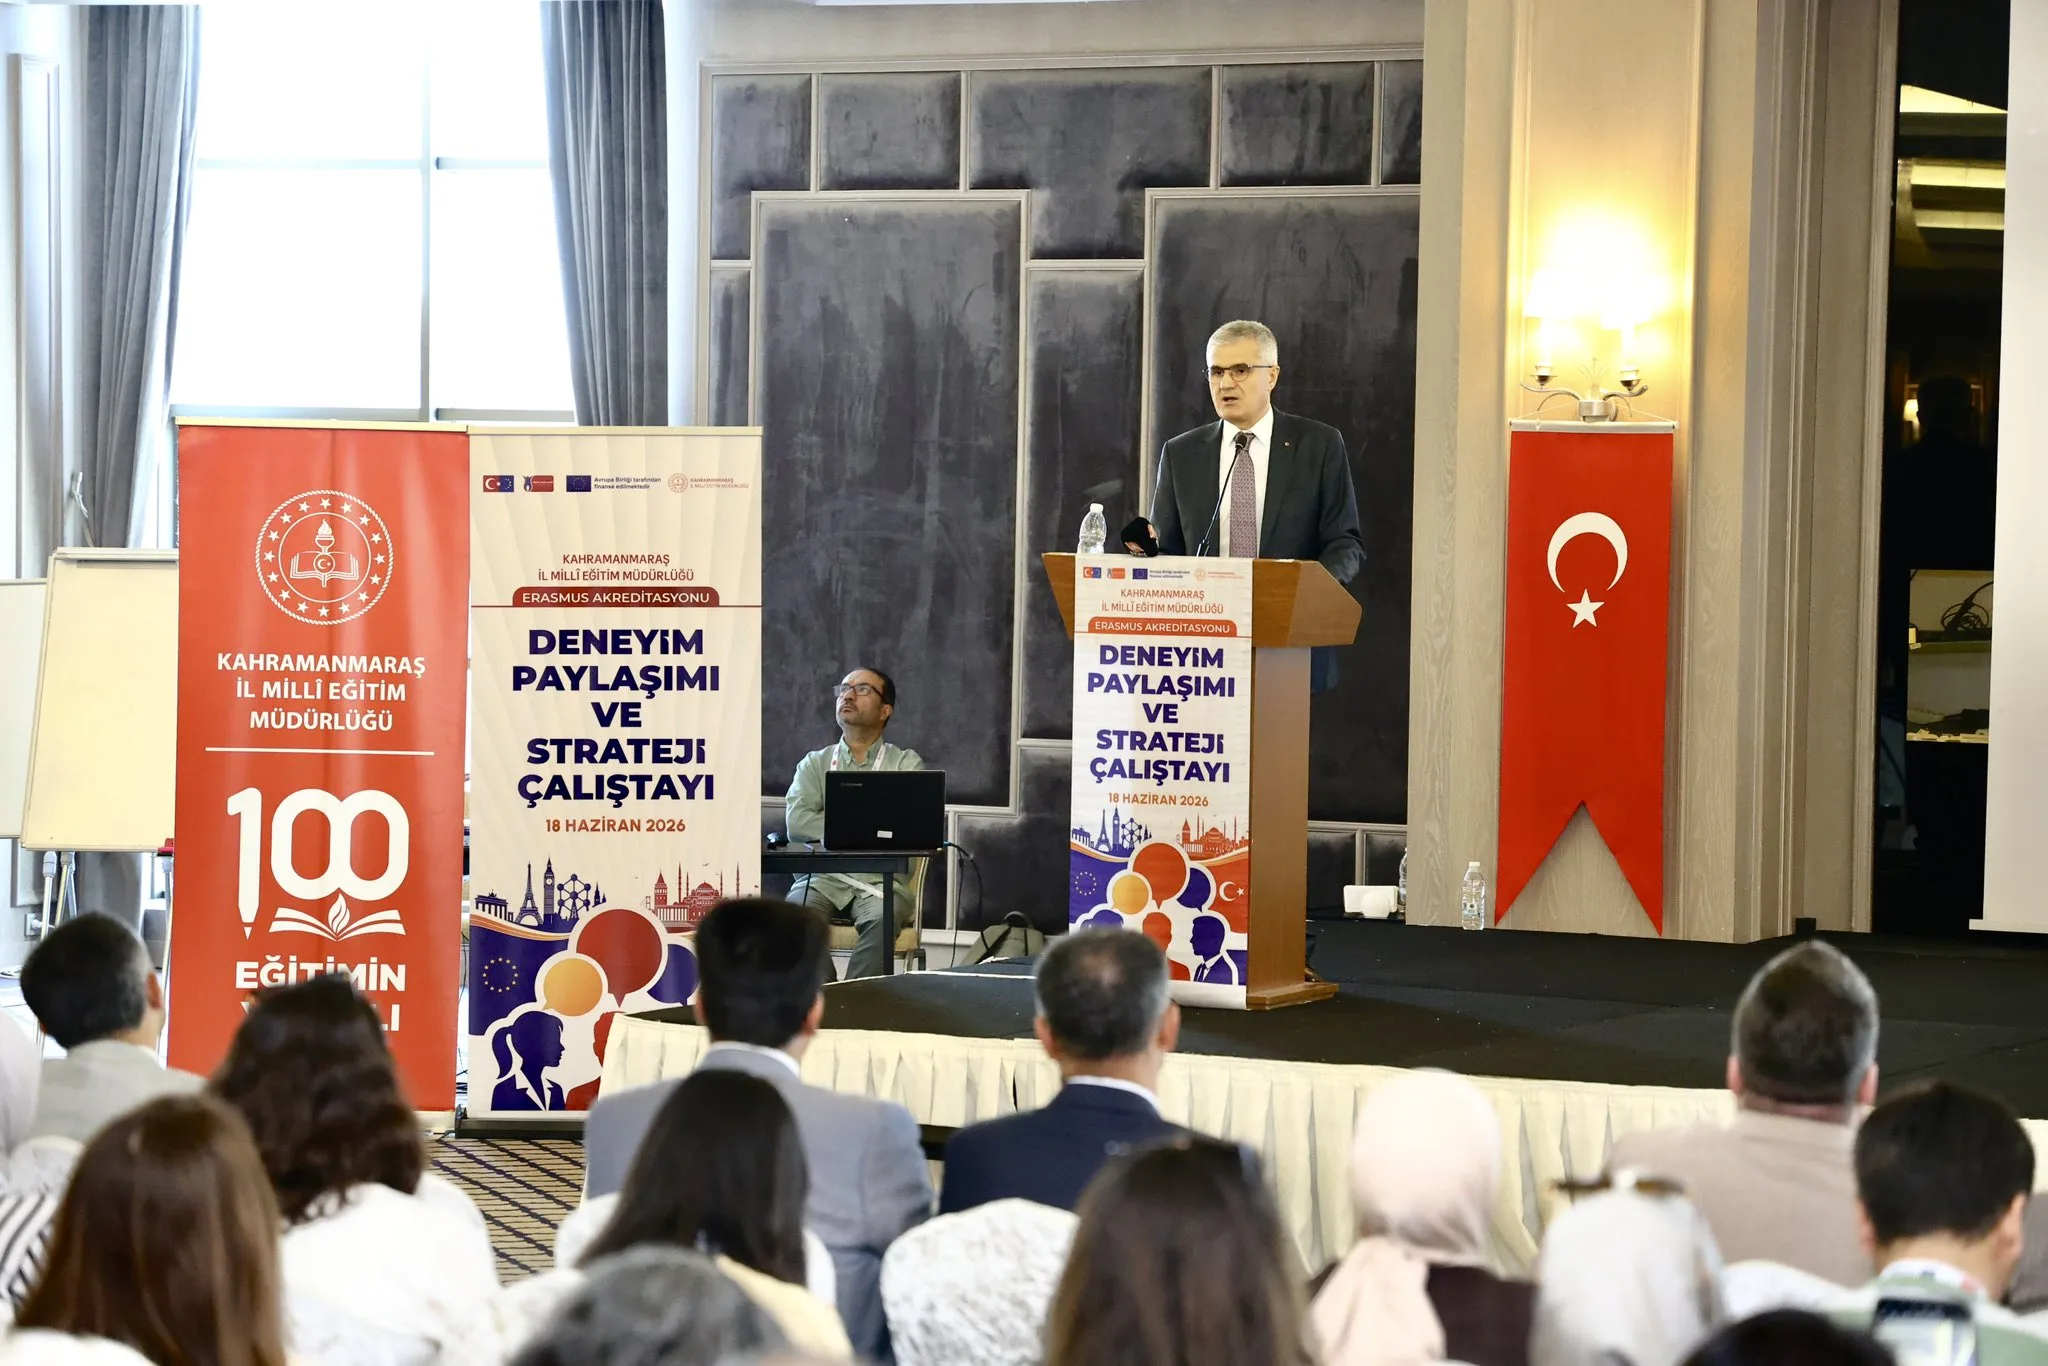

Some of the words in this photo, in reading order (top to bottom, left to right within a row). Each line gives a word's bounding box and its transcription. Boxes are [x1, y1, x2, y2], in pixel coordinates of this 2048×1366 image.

[594, 476, 614, 484] Avrupa
[563, 554, 669, 566] KAHRAMANMARAŞ
[539, 569, 548, 580] İL
[551, 568, 580, 580] MİLLÎ
[583, 569, 619, 581] EĞİTİM
[623, 569, 693, 581] MÜDÜRLÜĞÜ
[523, 593, 589, 603] ERASMUS
[592, 591, 709, 603] AKREDİTASYONU
[1120, 589, 1204, 601] KAHRAMANMARAŞ
[1102, 602, 1109, 611] İL
[1111, 601, 1134, 612] MİLLÎ
[1136, 602, 1165, 612] EĞİTİM
[1168, 603, 1223, 614] MÜDÜRLÜĞÜ
[1095, 622, 1142, 631] ERASMUS
[1145, 622, 1229, 633] AKREDİTASYONU
[529, 629, 703, 654] DENEYİM
[218, 653, 426, 678] KAHRAMANMARAŞ
[1100, 645, 1223, 668] DENEYİM
[237, 677, 255, 698] İL
[263, 678, 322, 699] MİLLÎ
[329, 678, 405, 701] EĞİTİM
[513, 665, 719, 699] PAYLAŞIMI
[1088, 673, 1235, 701] PAYLAŞIMI
[250, 708, 392, 731] MÜDÜRLÜĞÜ
[591, 702, 641, 727] VE
[1142, 703, 1178, 723] VE
[527, 738, 705, 764] STRATEJİ
[1097, 729, 1223, 754] STRATEJİ
[1090, 757, 1229, 786] ÇALIŞTAYI
[518, 774, 713, 808] ÇALIŞTAYI
[1109, 793, 1119, 803] 18
[1123, 792, 1176, 805] HAZİRAN
[1180, 795, 1208, 807] 2026
[546, 819, 560, 832] 18
[566, 816, 641, 832] HAZİRAN
[646, 819, 685, 832] 2026
[227, 787, 409, 940] 100
